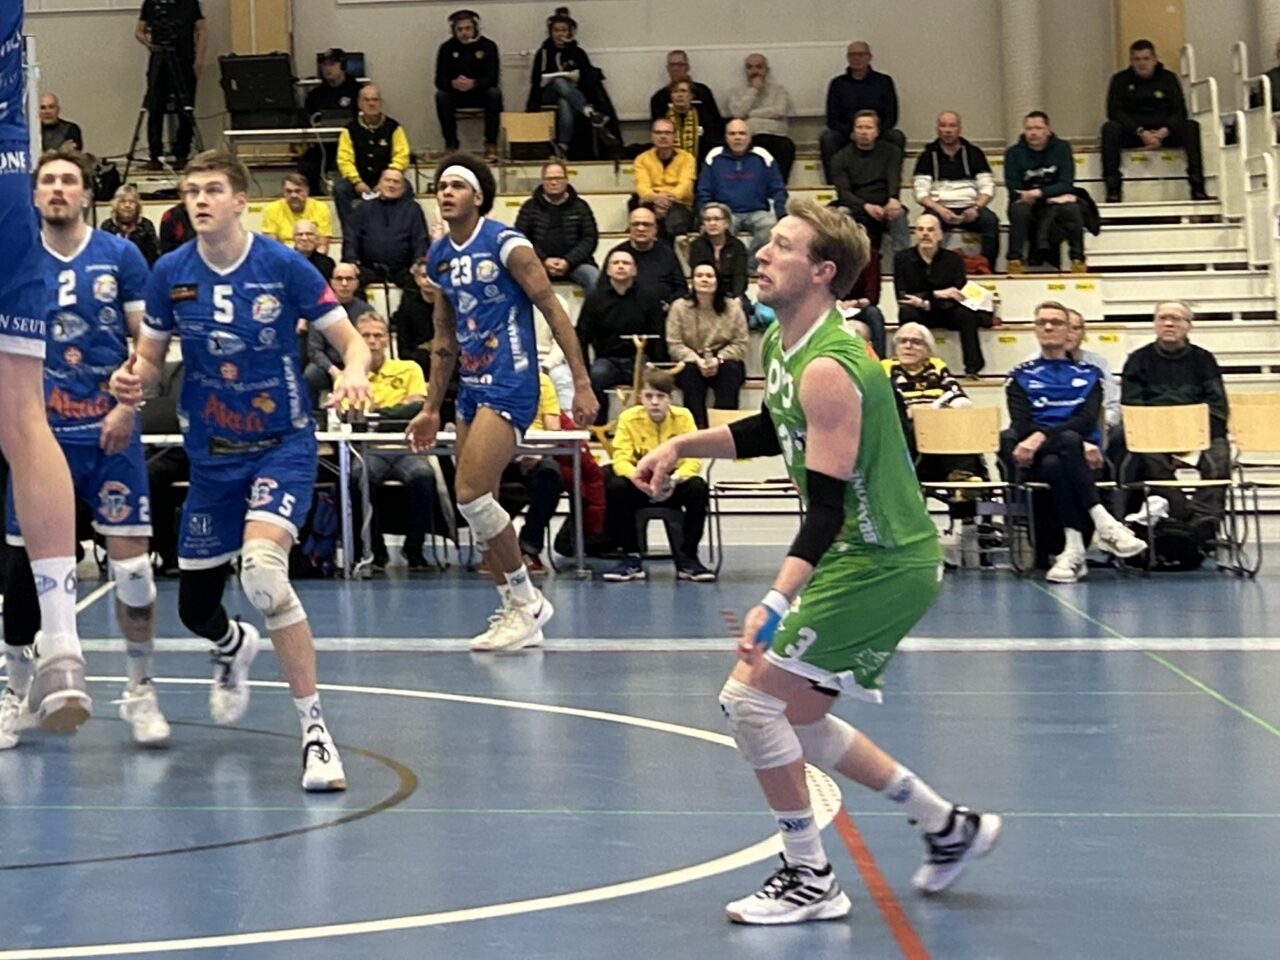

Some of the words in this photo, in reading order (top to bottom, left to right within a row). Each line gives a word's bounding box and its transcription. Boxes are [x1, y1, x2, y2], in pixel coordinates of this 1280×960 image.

[449, 254, 473, 287] 23
[57, 269, 78, 308] 2
[212, 284, 234, 324] 5
[138, 495, 150, 522] 2
[278, 492, 297, 518] 5
[785, 626, 817, 659] 3
